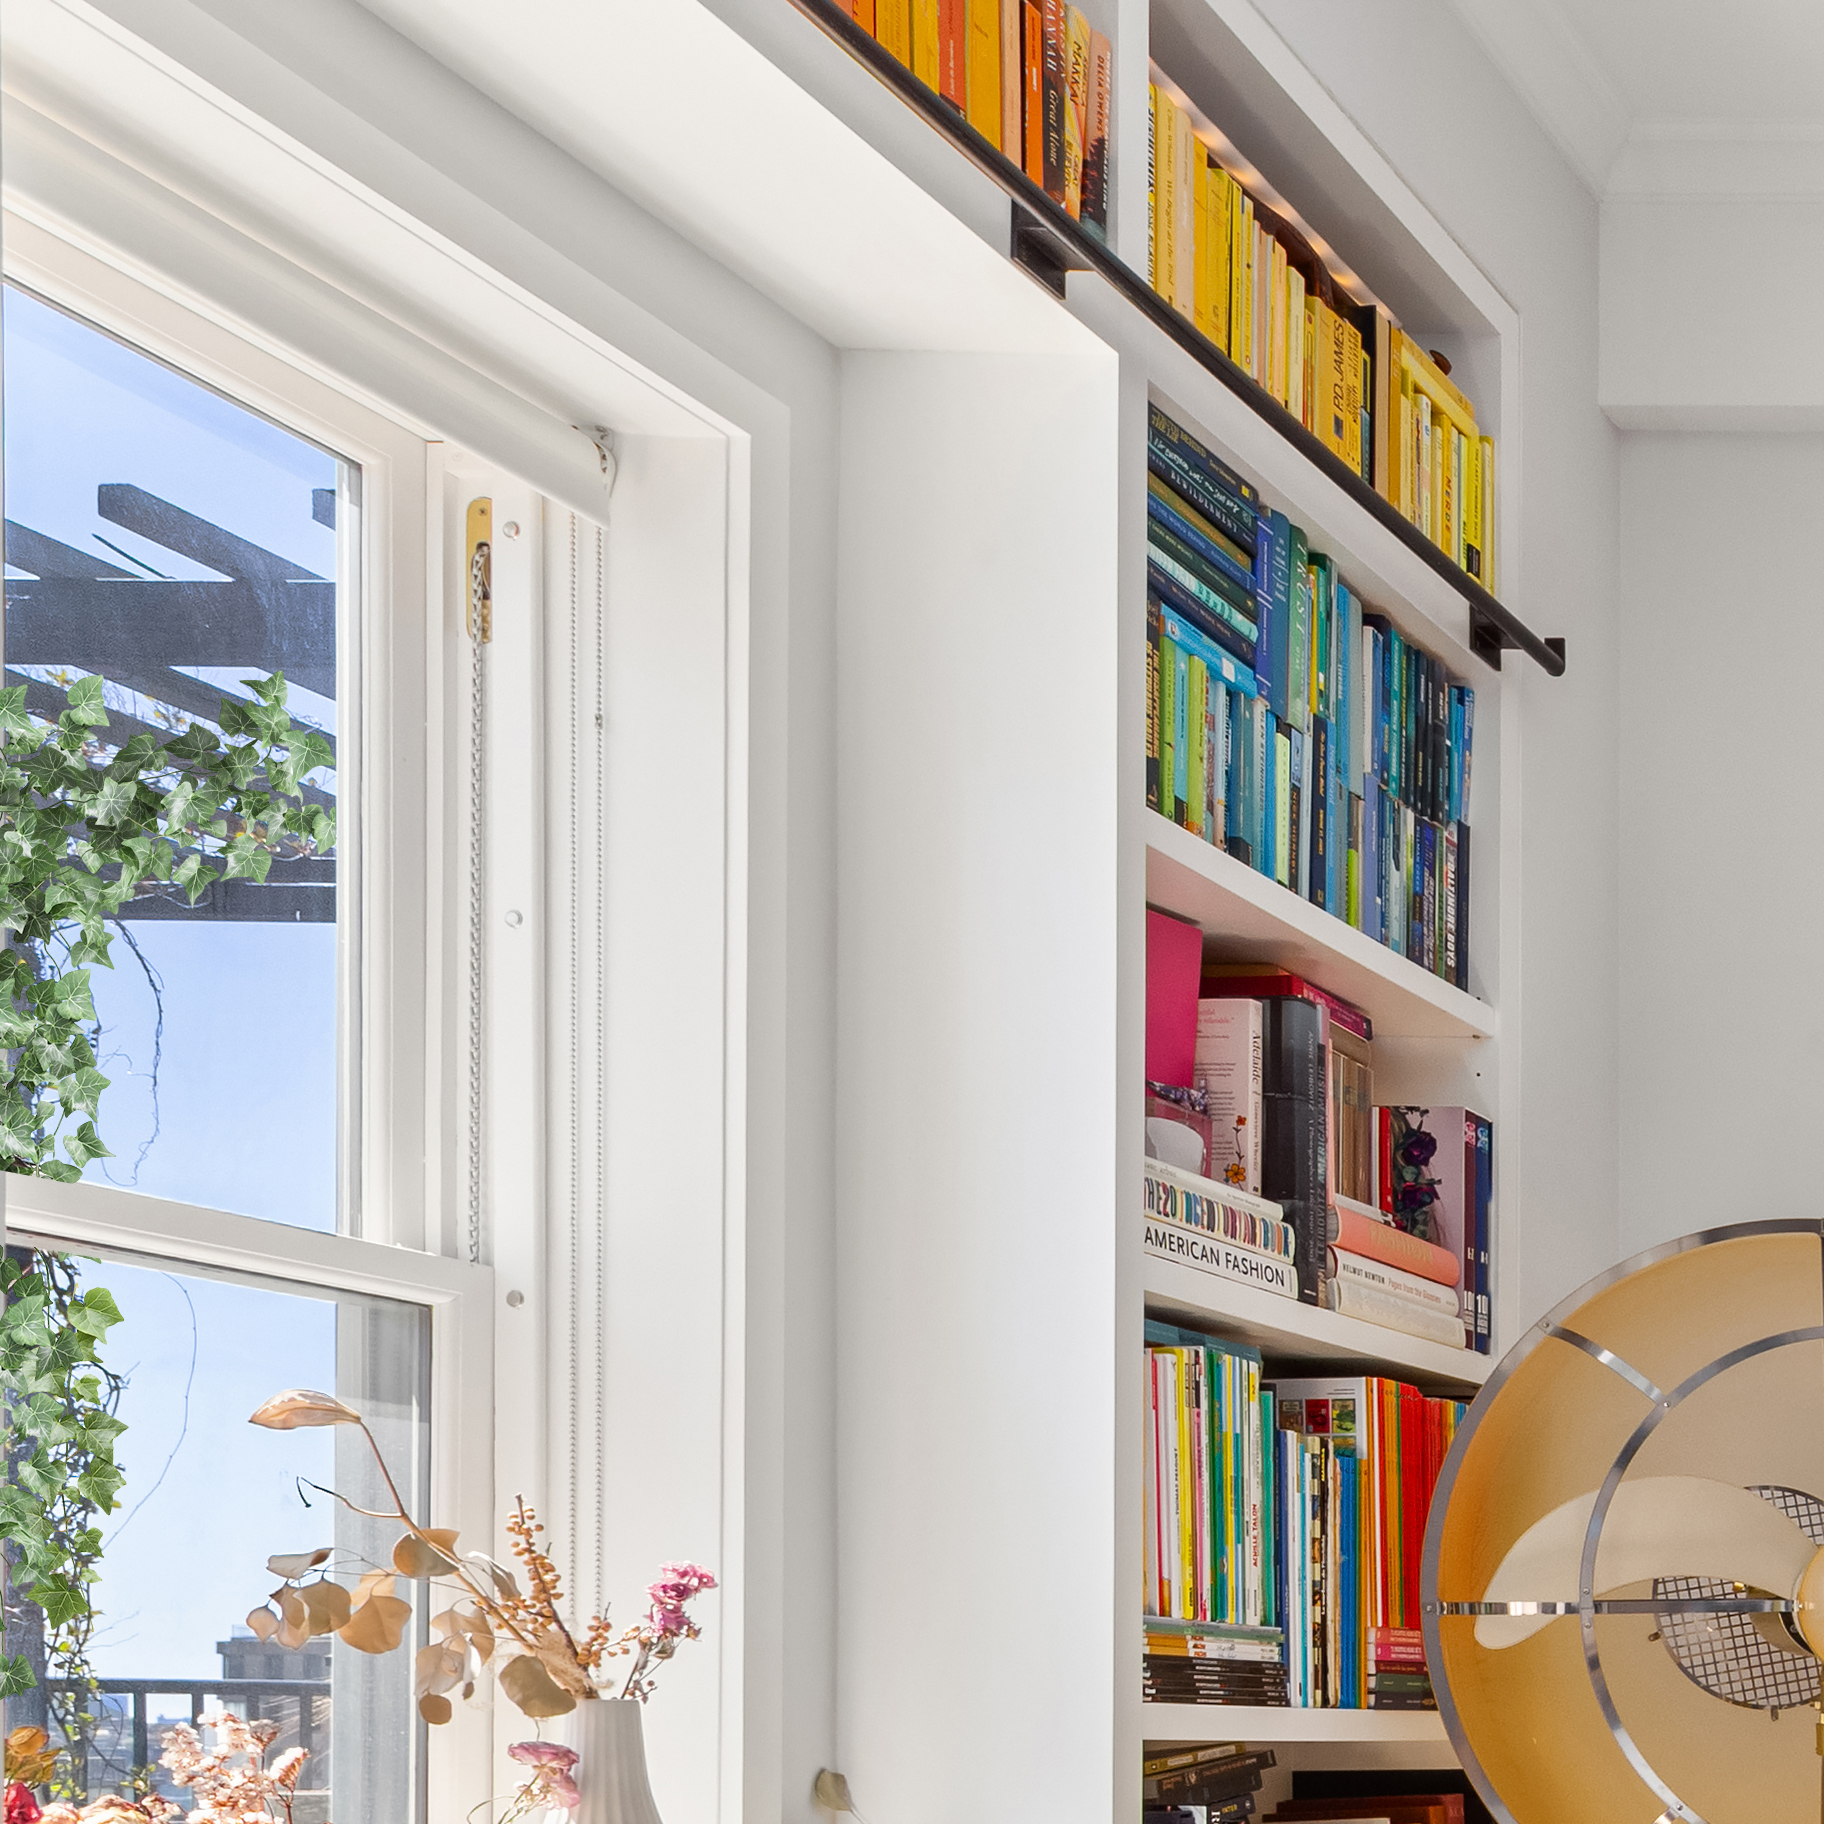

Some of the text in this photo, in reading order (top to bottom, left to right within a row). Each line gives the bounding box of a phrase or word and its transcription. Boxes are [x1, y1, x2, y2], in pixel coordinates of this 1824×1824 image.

[1070, 36, 1081, 110] MAKKAI
[1049, 86, 1060, 171] Great Alone
[1333, 319, 1345, 387] JAMES
[1296, 541, 1306, 637] TRUST
[1252, 1029, 1260, 1085] Adelaide
[1317, 1115, 1325, 1184] AMERICAN
[1145, 1228, 1284, 1288] AMERICAN FASHION
[1342, 1263, 1384, 1284] HELMUT NEWTON
